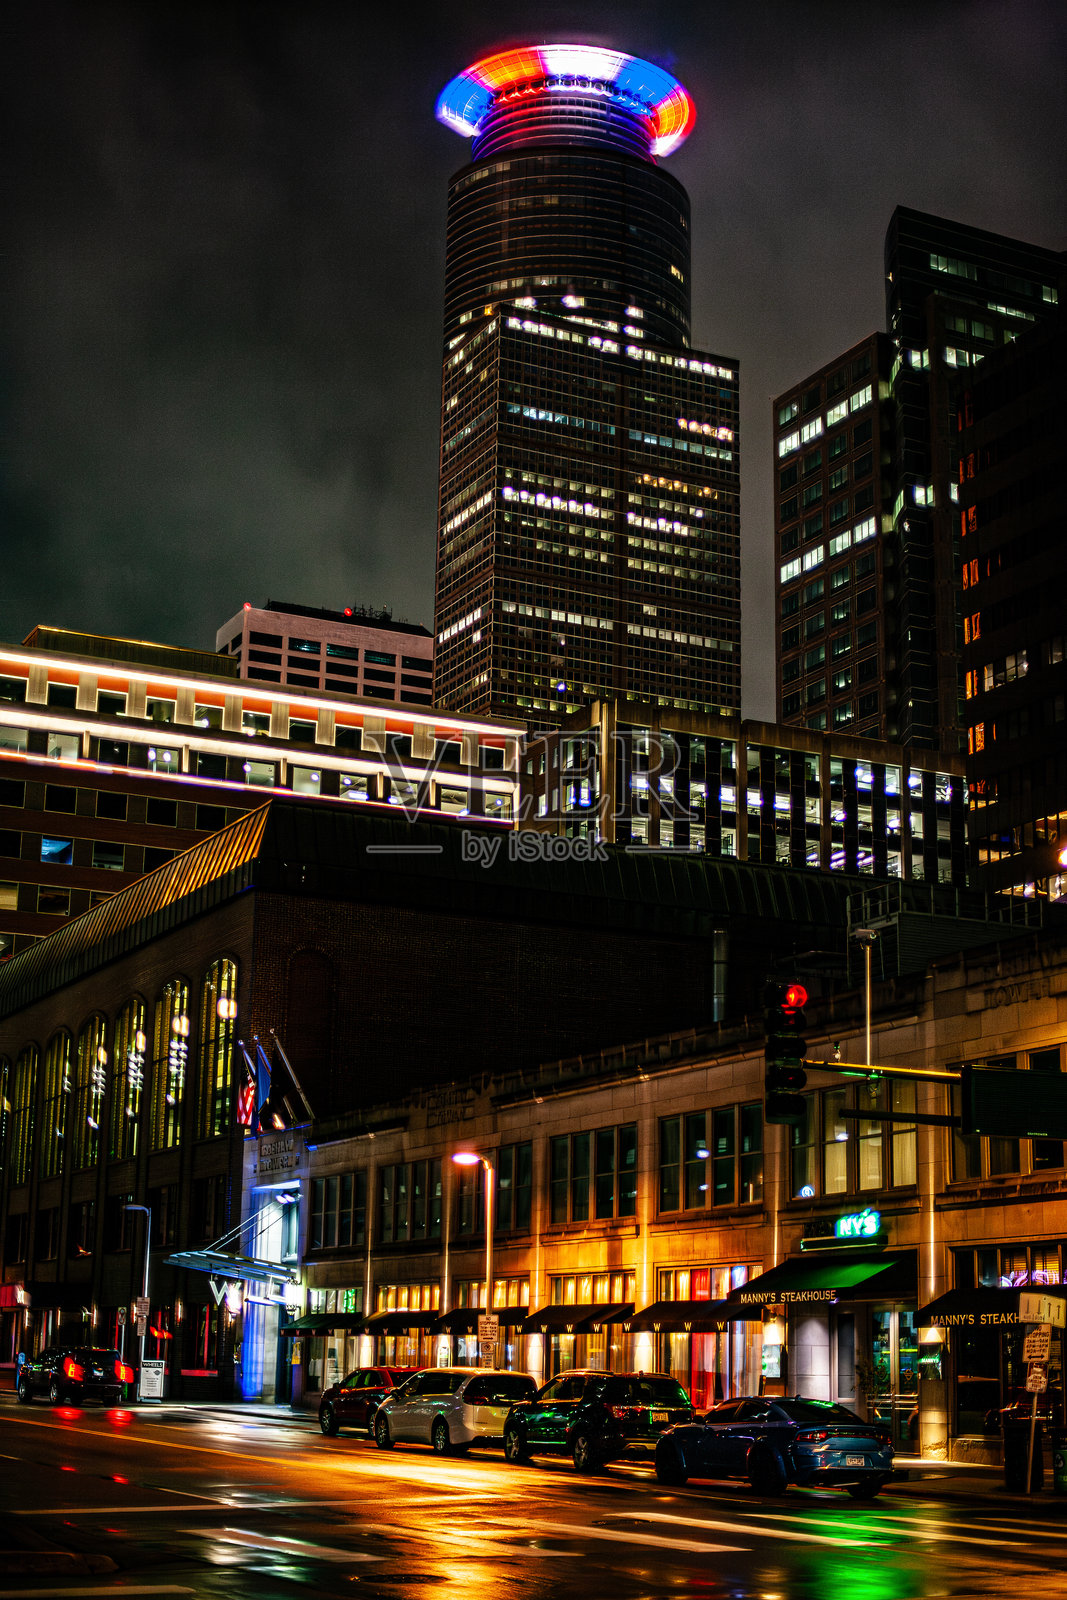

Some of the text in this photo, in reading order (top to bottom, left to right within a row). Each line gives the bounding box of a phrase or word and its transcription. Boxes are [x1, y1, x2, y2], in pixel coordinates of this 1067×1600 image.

[208, 1280, 243, 1307] W
[740, 1290, 837, 1304] MANNY'S STEAKHOUSE
[930, 1314, 975, 1326] MANNY'S
[980, 1312, 1019, 1325] STEAKH
[516, 1324, 523, 1333] W
[566, 1324, 573, 1333] W
[593, 1323, 600, 1333] W
[623, 1322, 725, 1332] W W W W
